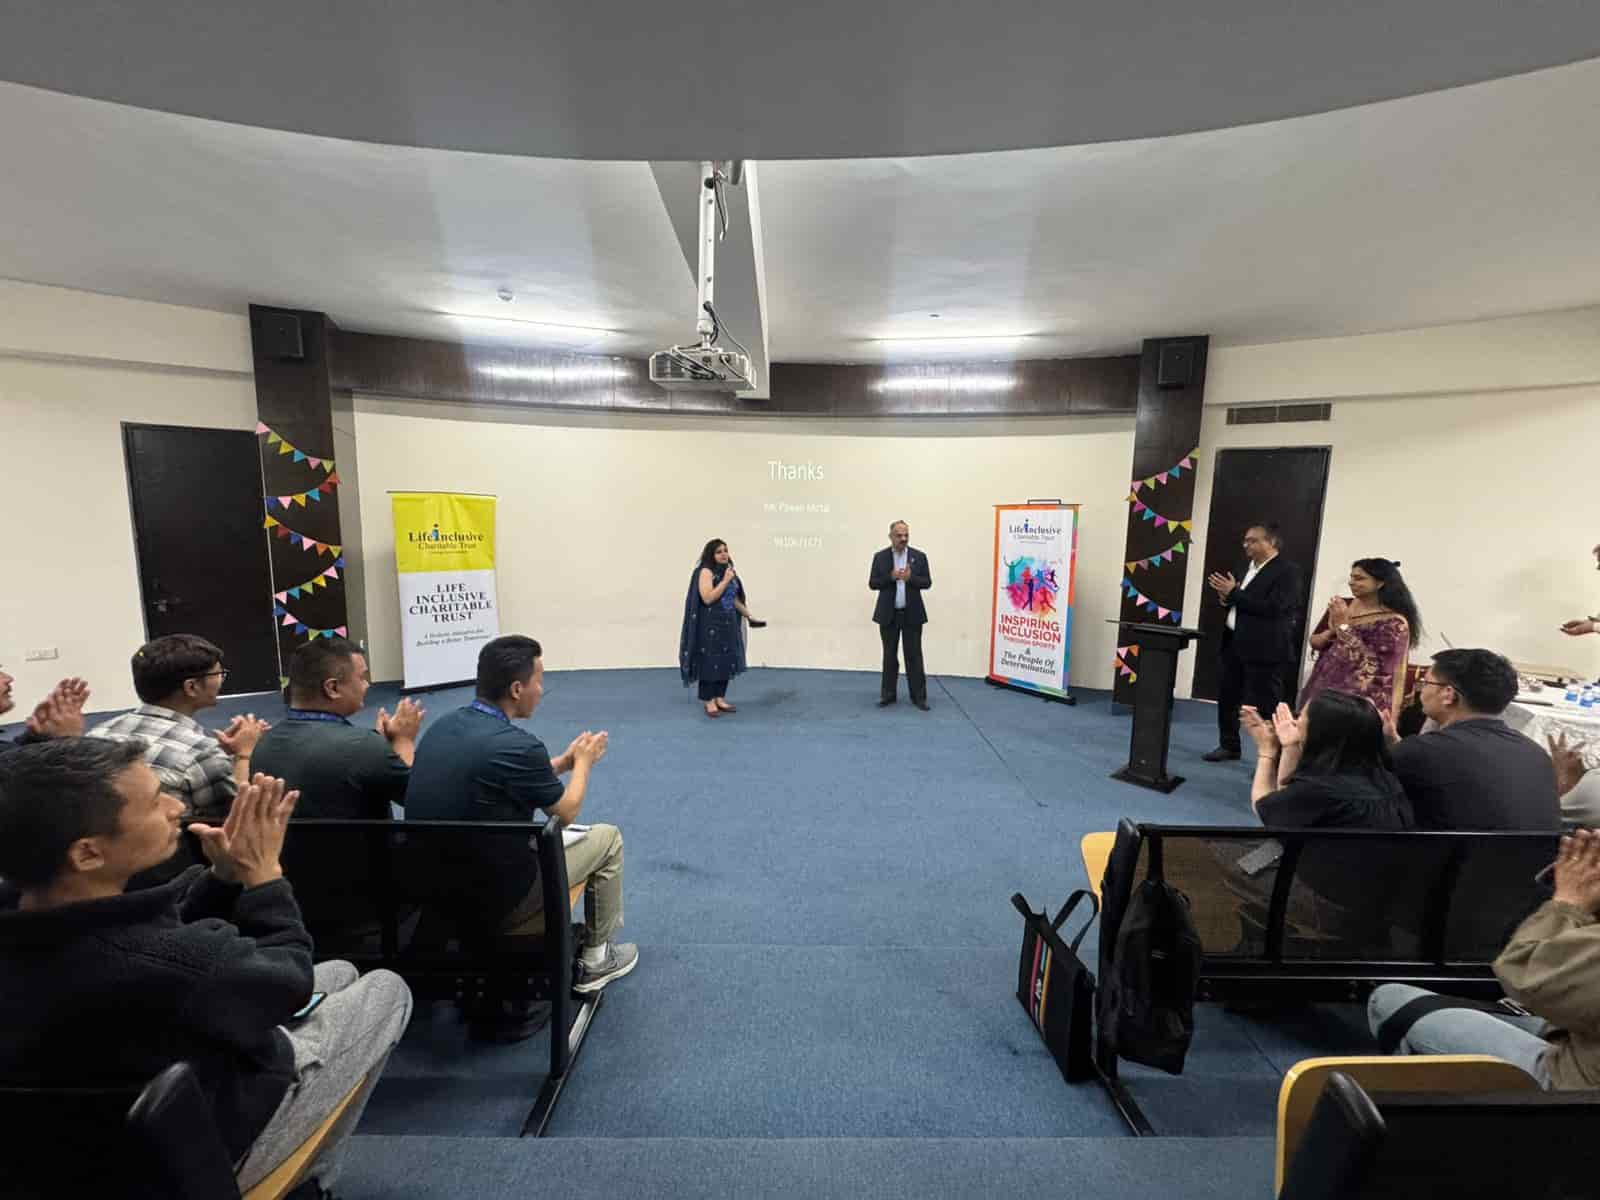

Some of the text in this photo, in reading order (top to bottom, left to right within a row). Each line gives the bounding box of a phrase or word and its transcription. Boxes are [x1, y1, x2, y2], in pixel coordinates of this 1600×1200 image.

[768, 459, 824, 480] Thanks
[437, 583, 465, 593] LIFE
[416, 592, 487, 605] INCLUSIVE
[409, 600, 493, 615] CHARITABLE
[432, 611, 472, 623] TRUST
[1001, 614, 1059, 632] INSPIRING
[999, 624, 1061, 643] INCLUSION
[1005, 650, 1055, 669] The People Of
